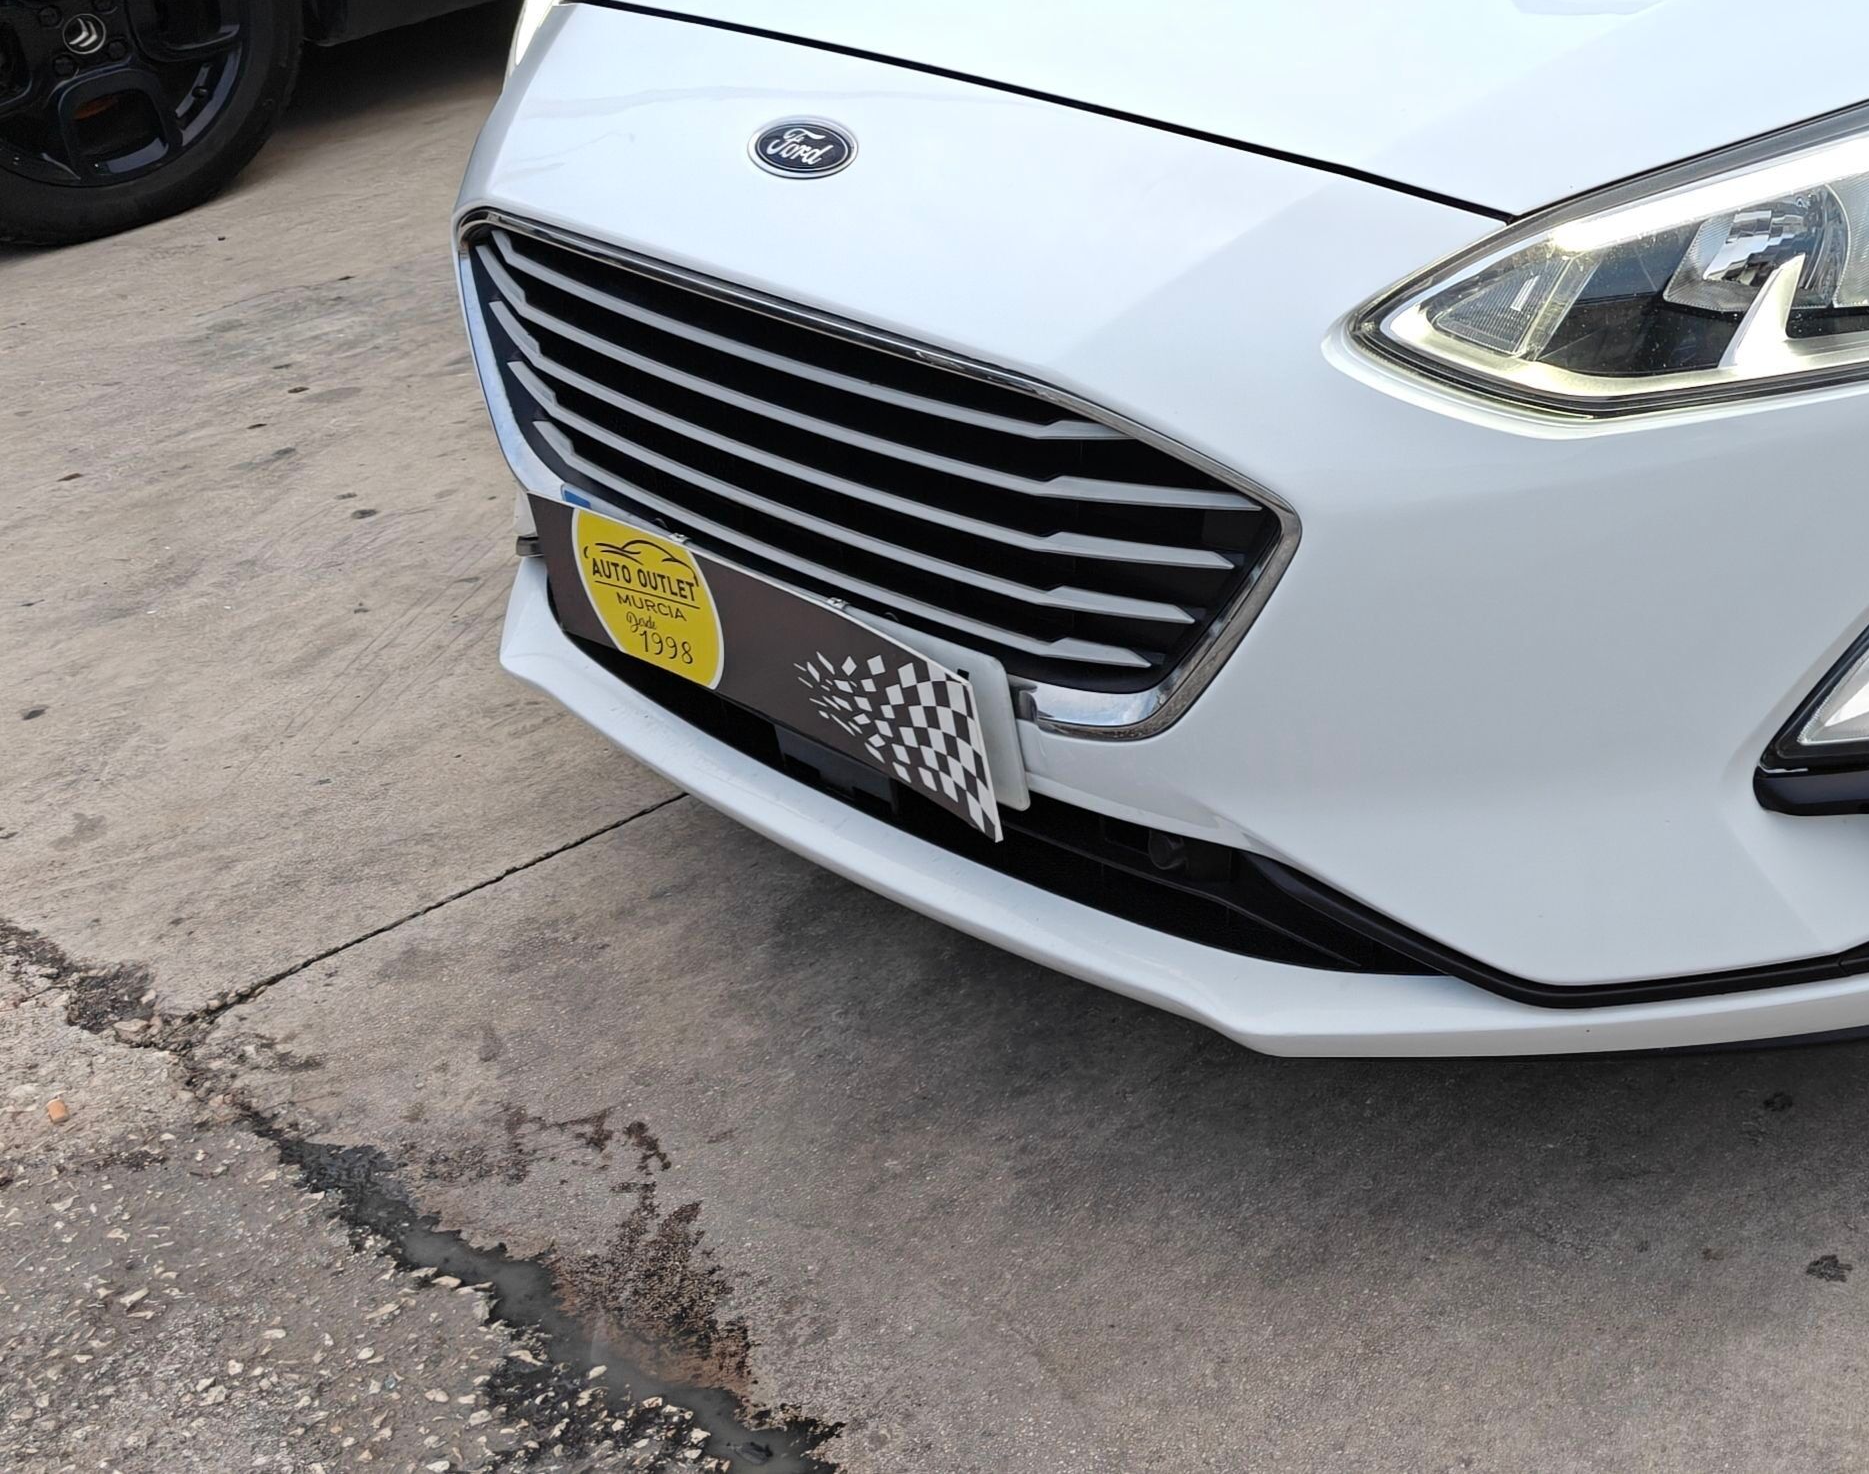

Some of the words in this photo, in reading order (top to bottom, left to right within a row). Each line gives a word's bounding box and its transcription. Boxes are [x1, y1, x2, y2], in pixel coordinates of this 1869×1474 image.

[766, 128, 834, 165] Ford
[592, 557, 631, 584] AUTO
[637, 568, 695, 601] OUTLET
[616, 592, 687, 622] MURCIA
[639, 630, 694, 664] 1998
